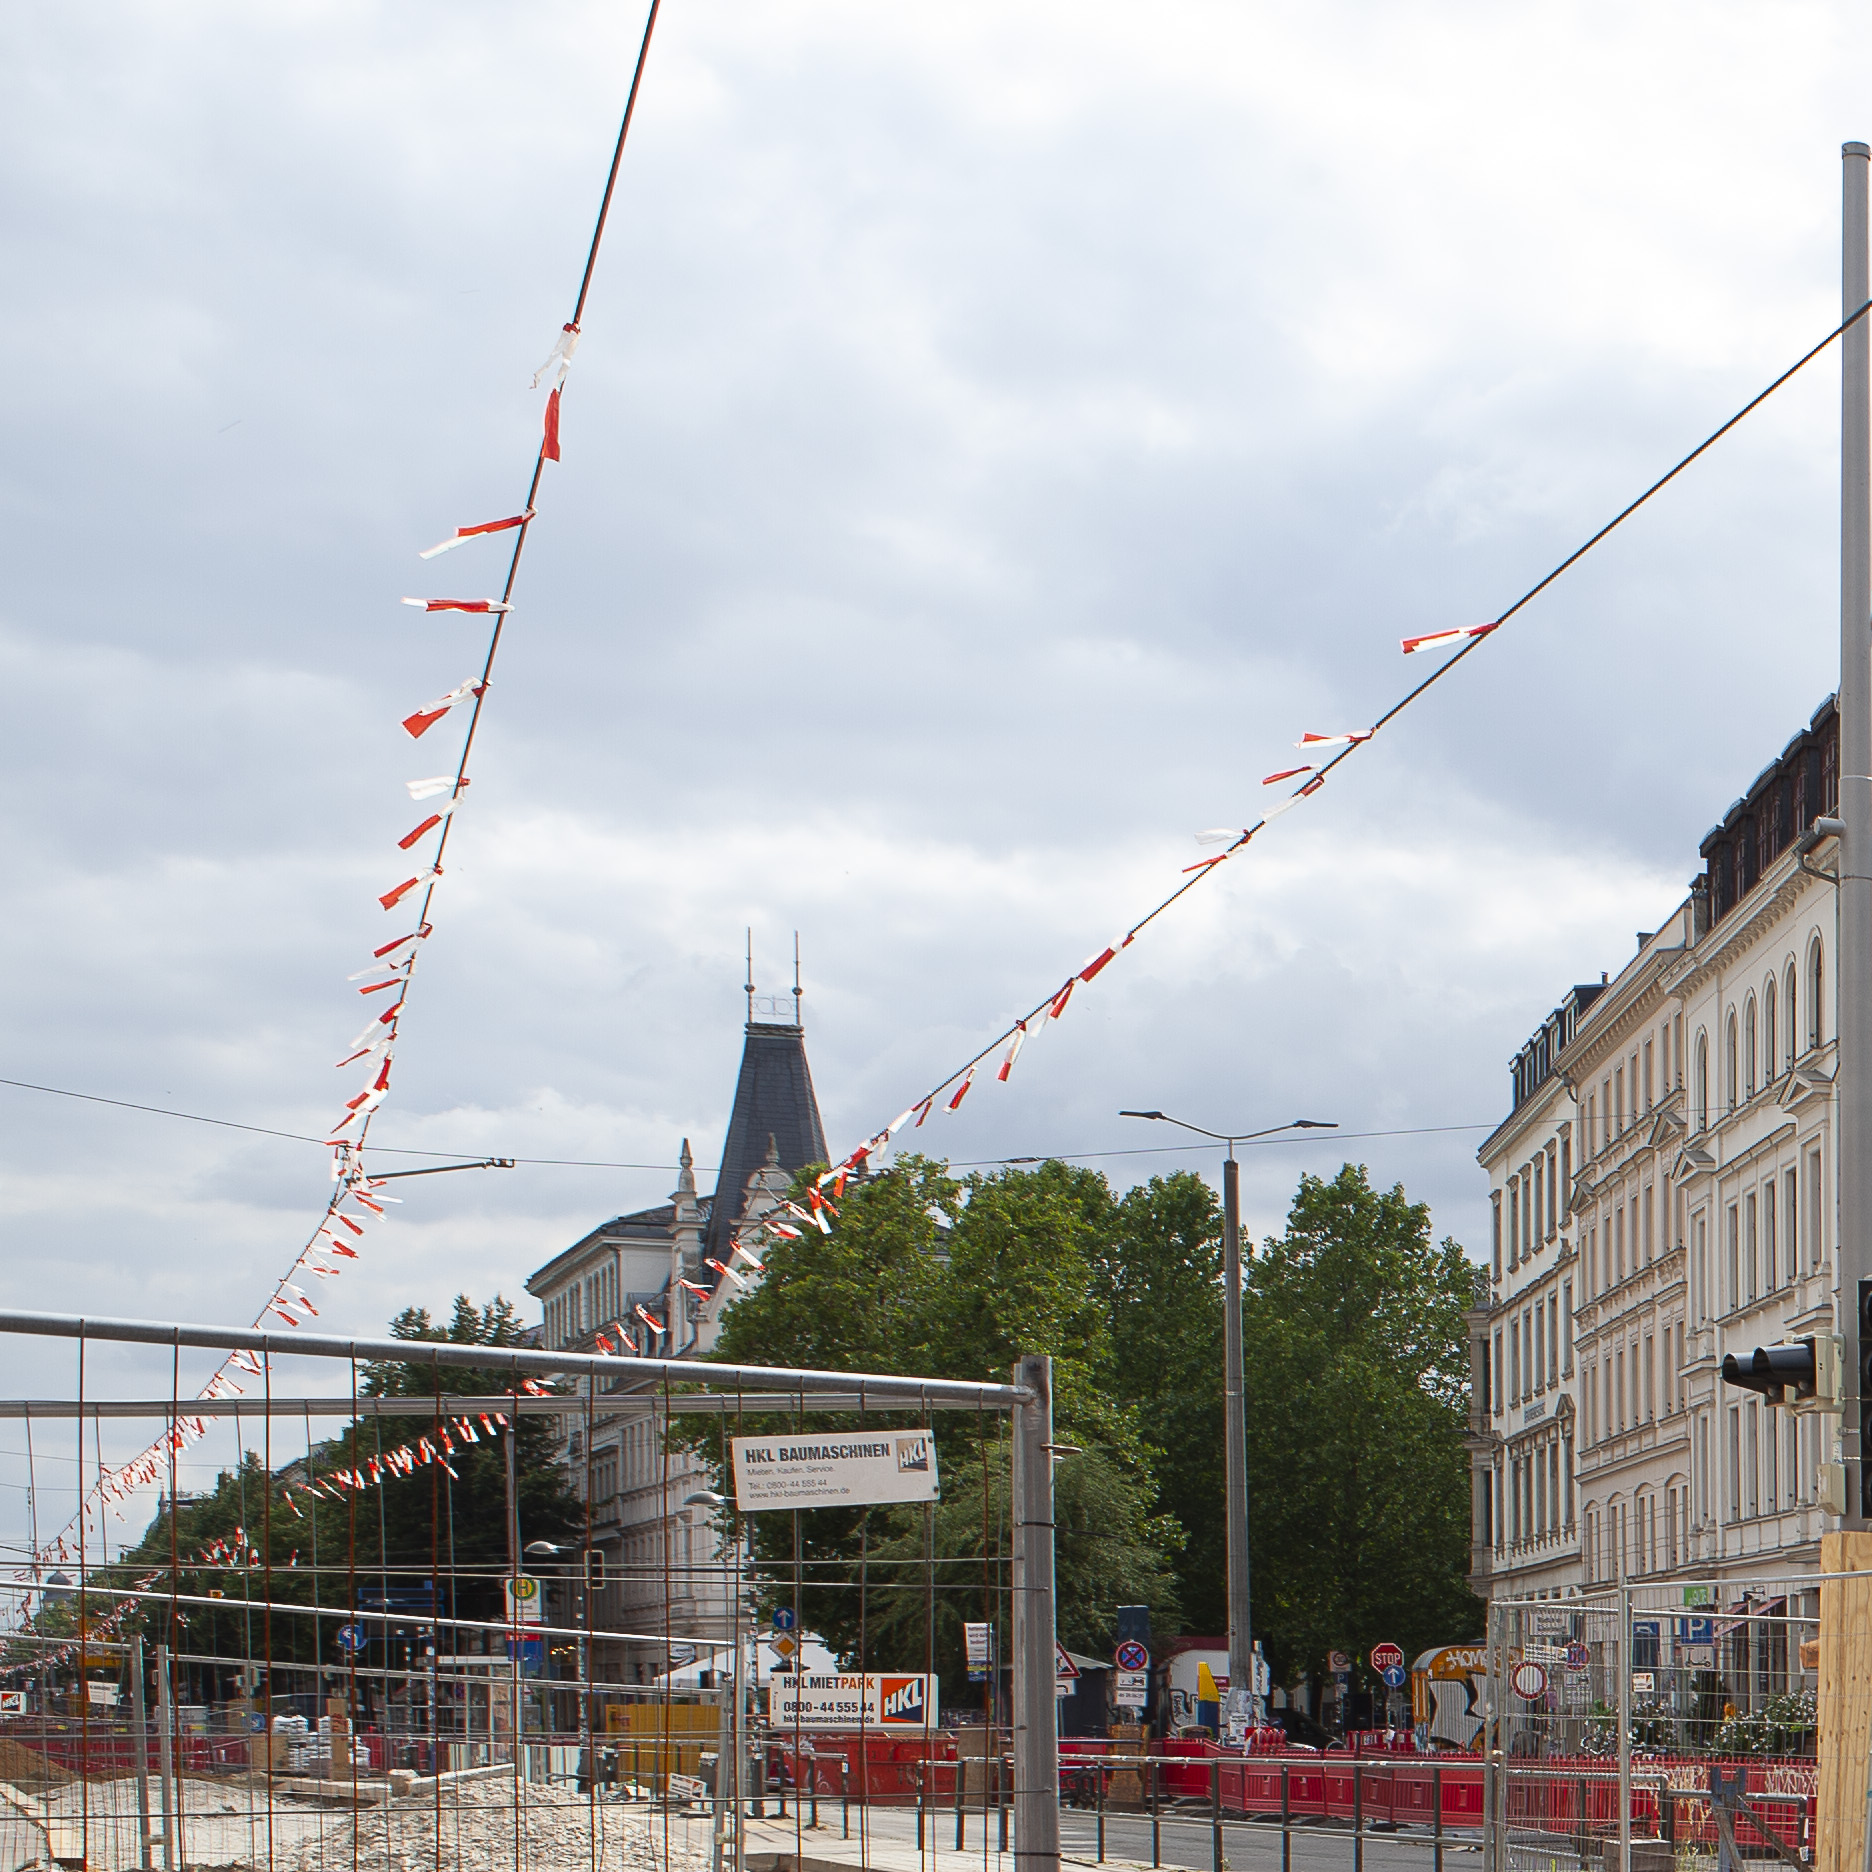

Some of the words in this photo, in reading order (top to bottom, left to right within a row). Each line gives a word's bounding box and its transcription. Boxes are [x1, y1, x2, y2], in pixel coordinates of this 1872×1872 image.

[745, 1448, 776, 1463] HKL
[779, 1443, 890, 1462] BAUMASCHINEN
[899, 1437, 928, 1468] HKL
[1374, 1652, 1401, 1665] STOP
[838, 1701, 858, 1713] 555
[884, 1679, 922, 1717] HKL
